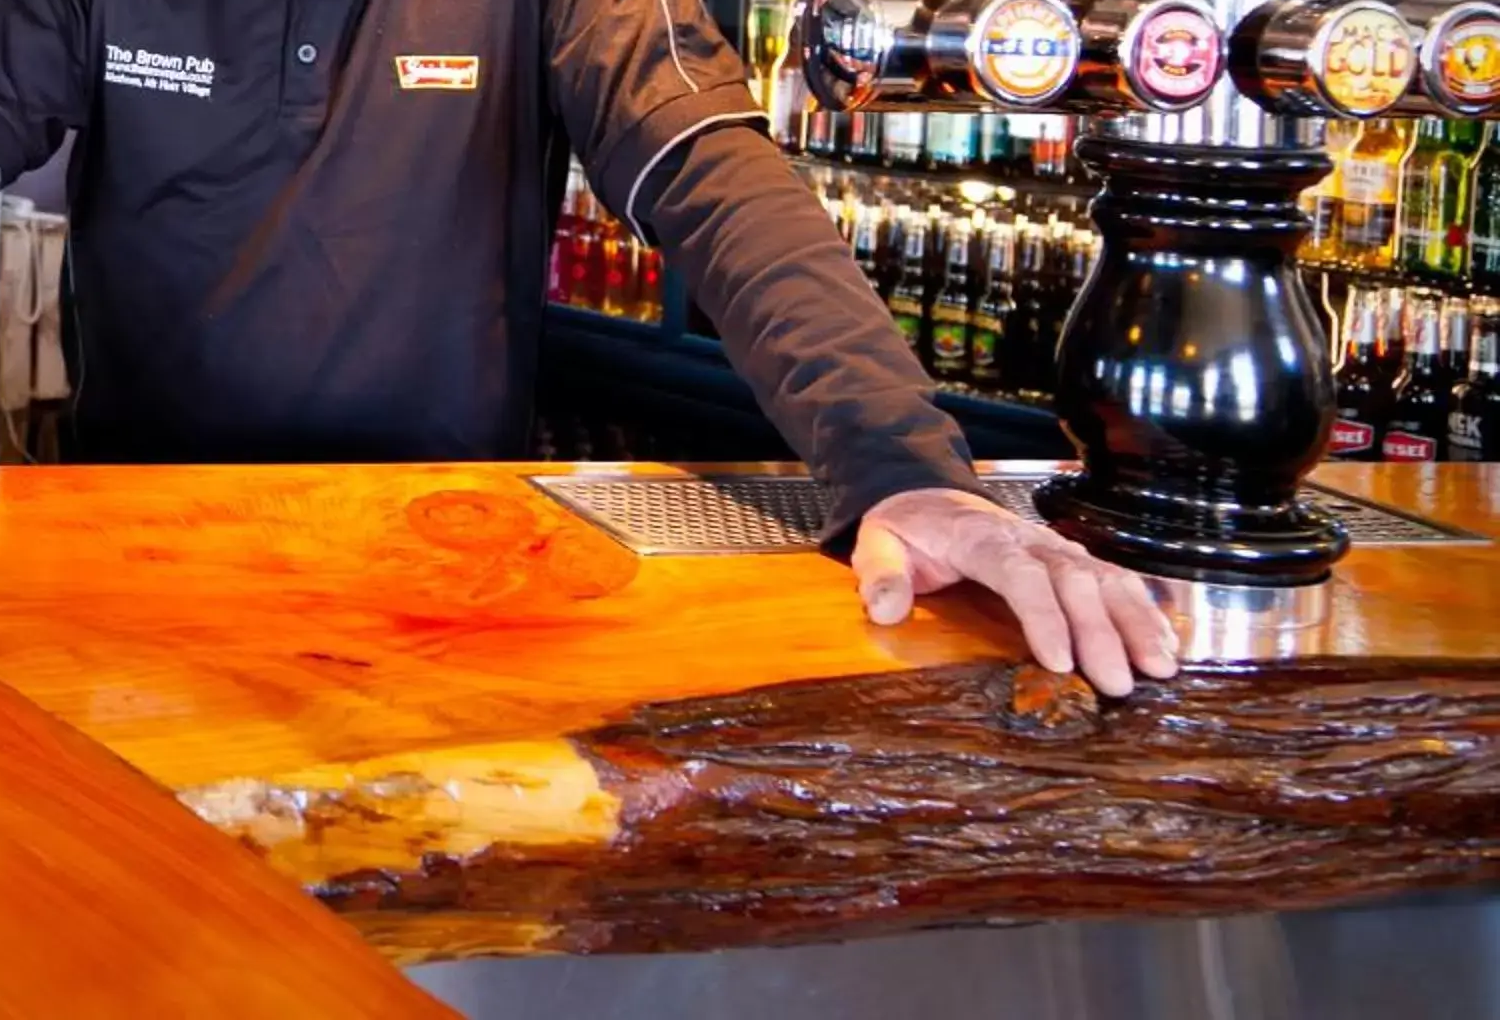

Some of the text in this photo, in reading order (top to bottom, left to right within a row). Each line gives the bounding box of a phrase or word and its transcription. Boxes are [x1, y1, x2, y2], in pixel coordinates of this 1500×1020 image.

[105, 44, 215, 74] The Brown Pub
[1327, 39, 1409, 78] GOLD
